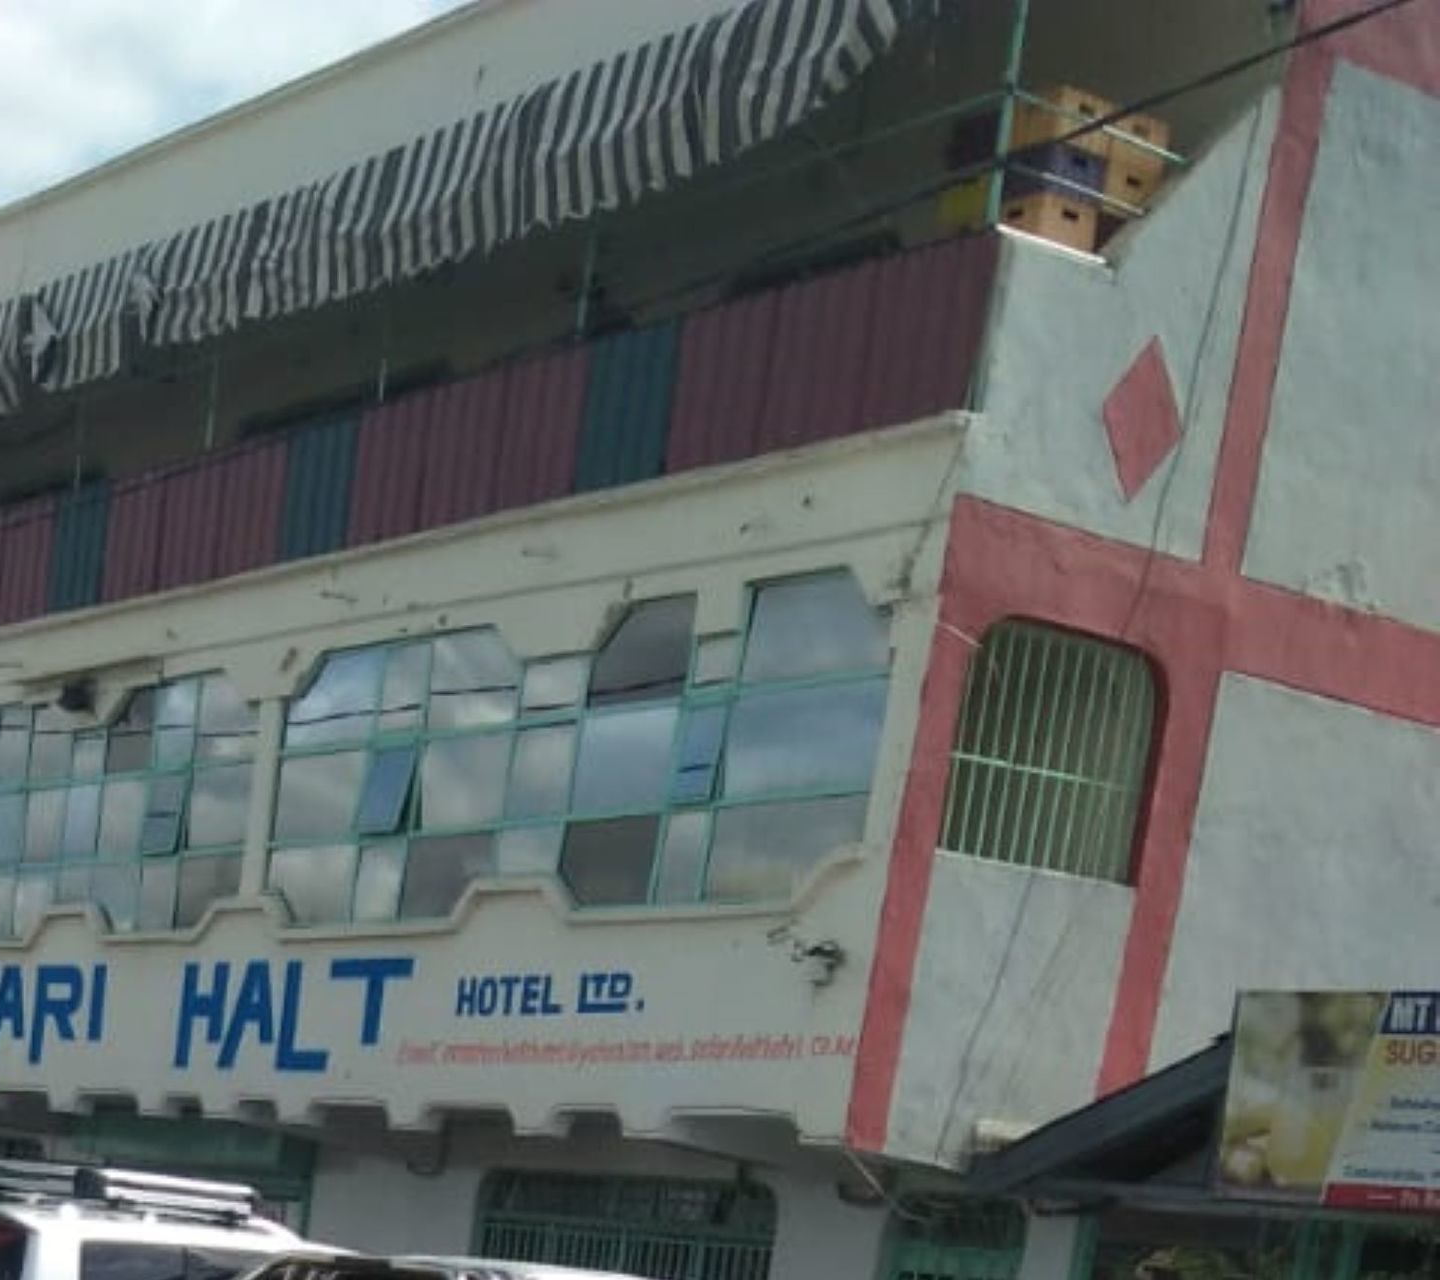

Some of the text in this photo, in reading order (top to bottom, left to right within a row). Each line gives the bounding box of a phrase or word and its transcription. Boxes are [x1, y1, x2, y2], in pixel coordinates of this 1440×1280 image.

[174, 957, 414, 1072] HALT
[456, 974, 563, 1016] HOTEL
[1389, 996, 1432, 1032] MT
